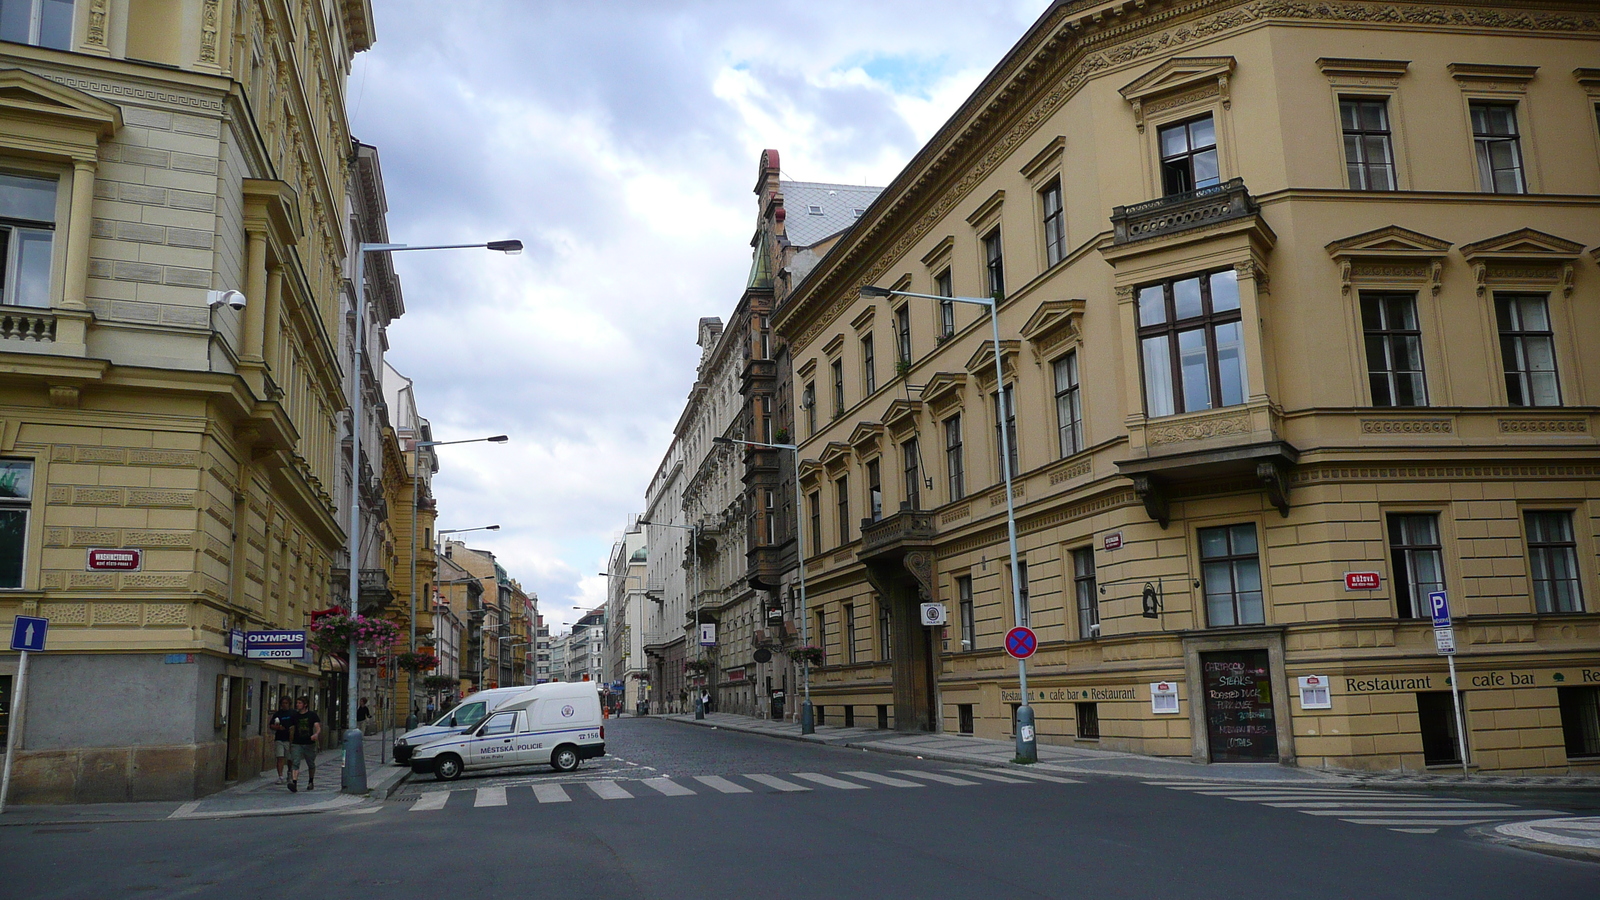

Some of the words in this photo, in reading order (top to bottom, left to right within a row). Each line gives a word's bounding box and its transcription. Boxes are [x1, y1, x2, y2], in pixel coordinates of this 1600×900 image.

[1432, 596, 1444, 616] P
[248, 634, 304, 642] OLYMPUS
[1346, 676, 1432, 691] Restaurant
[1472, 671, 1505, 687] cafe
[1510, 671, 1534, 685] bar
[1001, 690, 1035, 701] Restaunt
[1049, 690, 1065, 700] cafe
[1066, 688, 1079, 700] bar
[1091, 687, 1136, 700] Restaurant
[480, 745, 514, 754] MĚSTSKÁ
[517, 743, 543, 751] POLICIE
